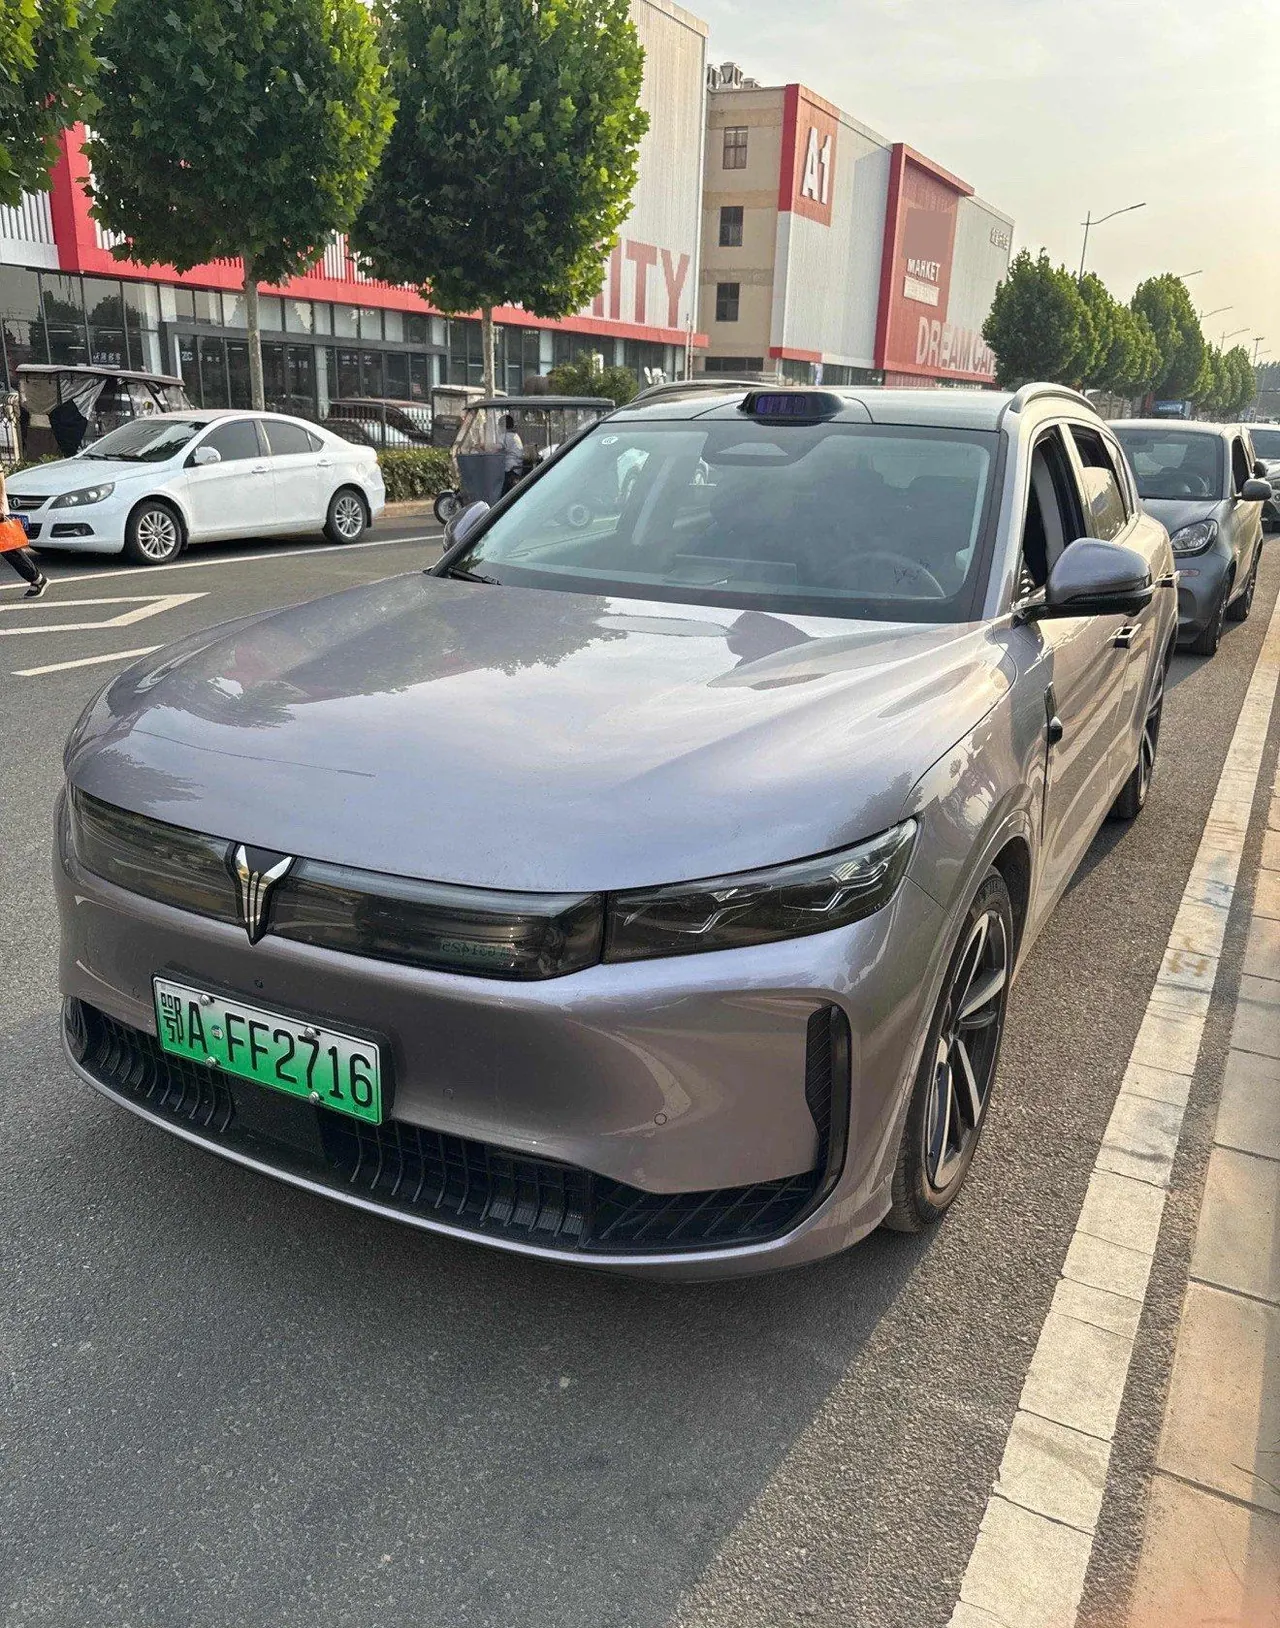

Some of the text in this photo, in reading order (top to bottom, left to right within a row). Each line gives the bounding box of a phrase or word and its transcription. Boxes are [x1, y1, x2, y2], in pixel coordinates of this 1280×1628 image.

[801, 126, 833, 205] A1
[593, 235, 691, 329] ITY
[906, 258, 941, 283] MARKET
[915, 316, 972, 372] DREAM
